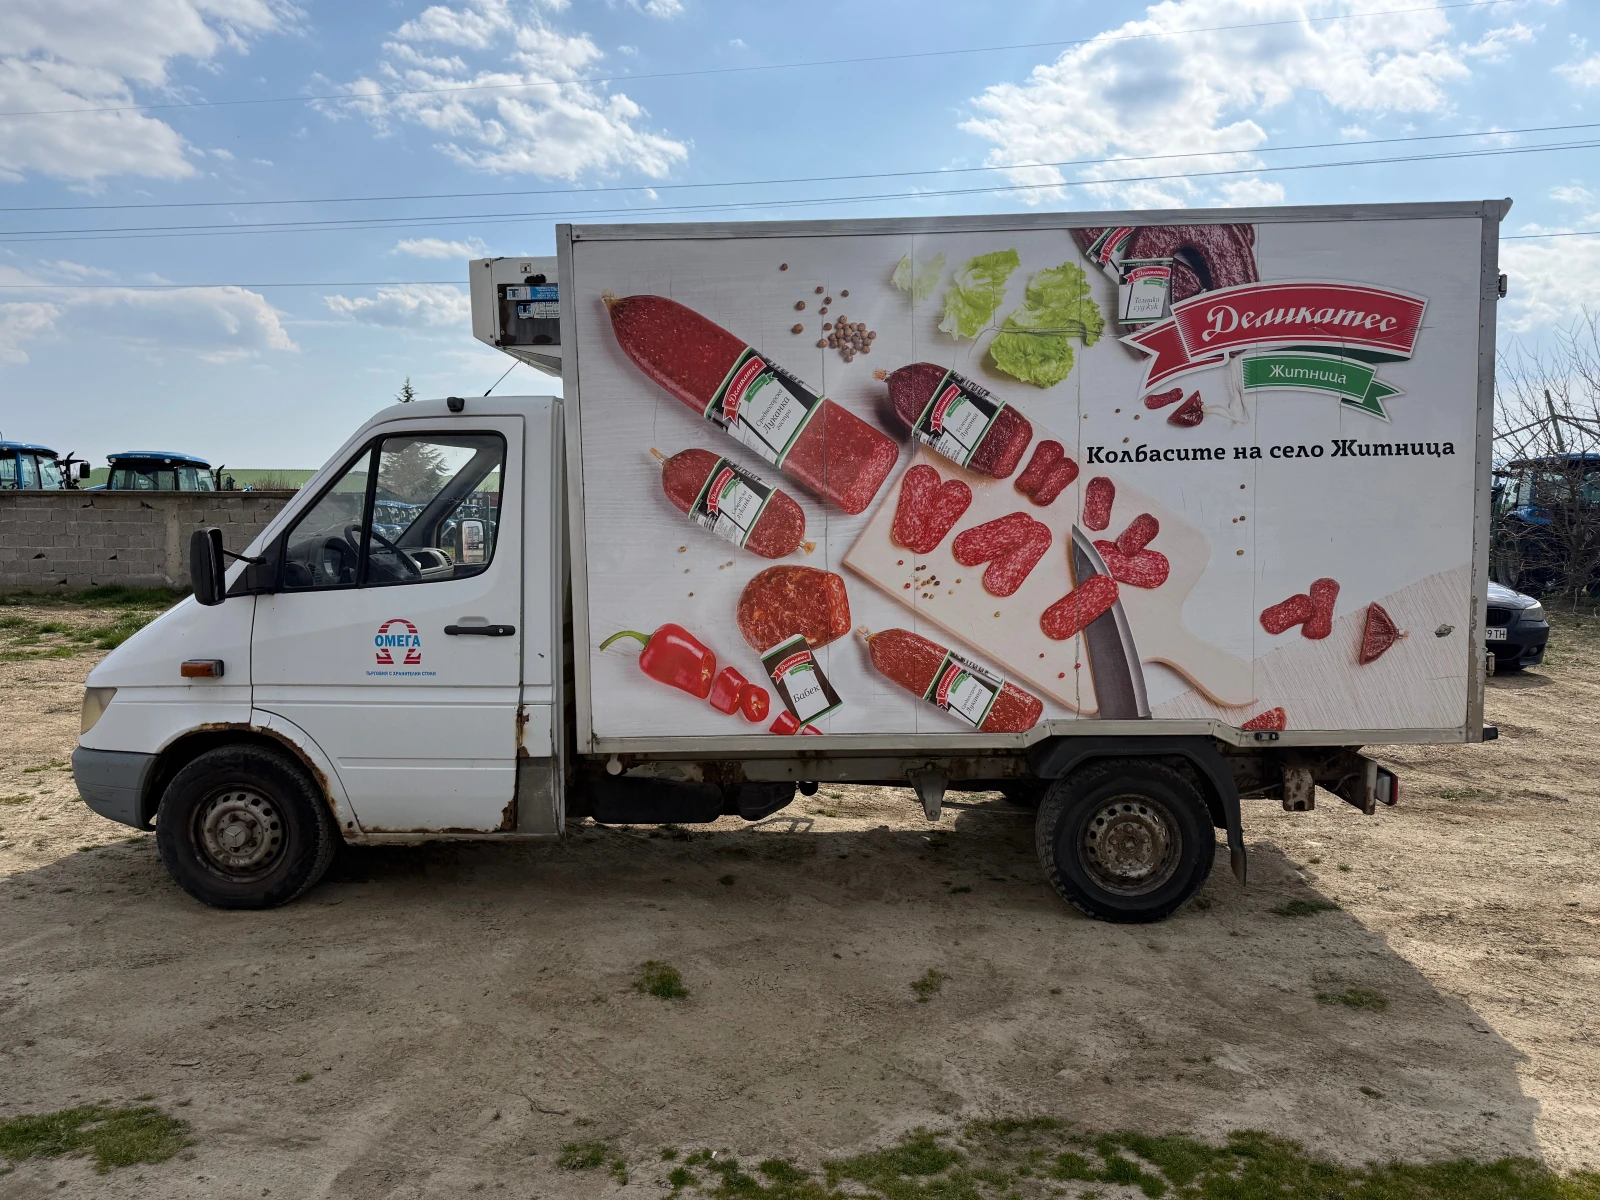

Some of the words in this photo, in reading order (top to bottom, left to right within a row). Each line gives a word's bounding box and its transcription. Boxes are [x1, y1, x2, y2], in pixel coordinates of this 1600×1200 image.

[1201, 302, 1398, 343] Деликатес
[728, 361, 760, 406] Деликатес
[1268, 364, 1348, 386] Житница
[765, 396, 791, 434] Луканка
[1086, 443, 1226, 464] Колбасите
[1233, 443, 1263, 460] на
[1269, 443, 1325, 460] село
[1330, 438, 1456, 459] Житница
[374, 634, 421, 648] ОМЕГА
[1486, 629, 1493, 638] 9
[792, 685, 821, 704] Бабек
